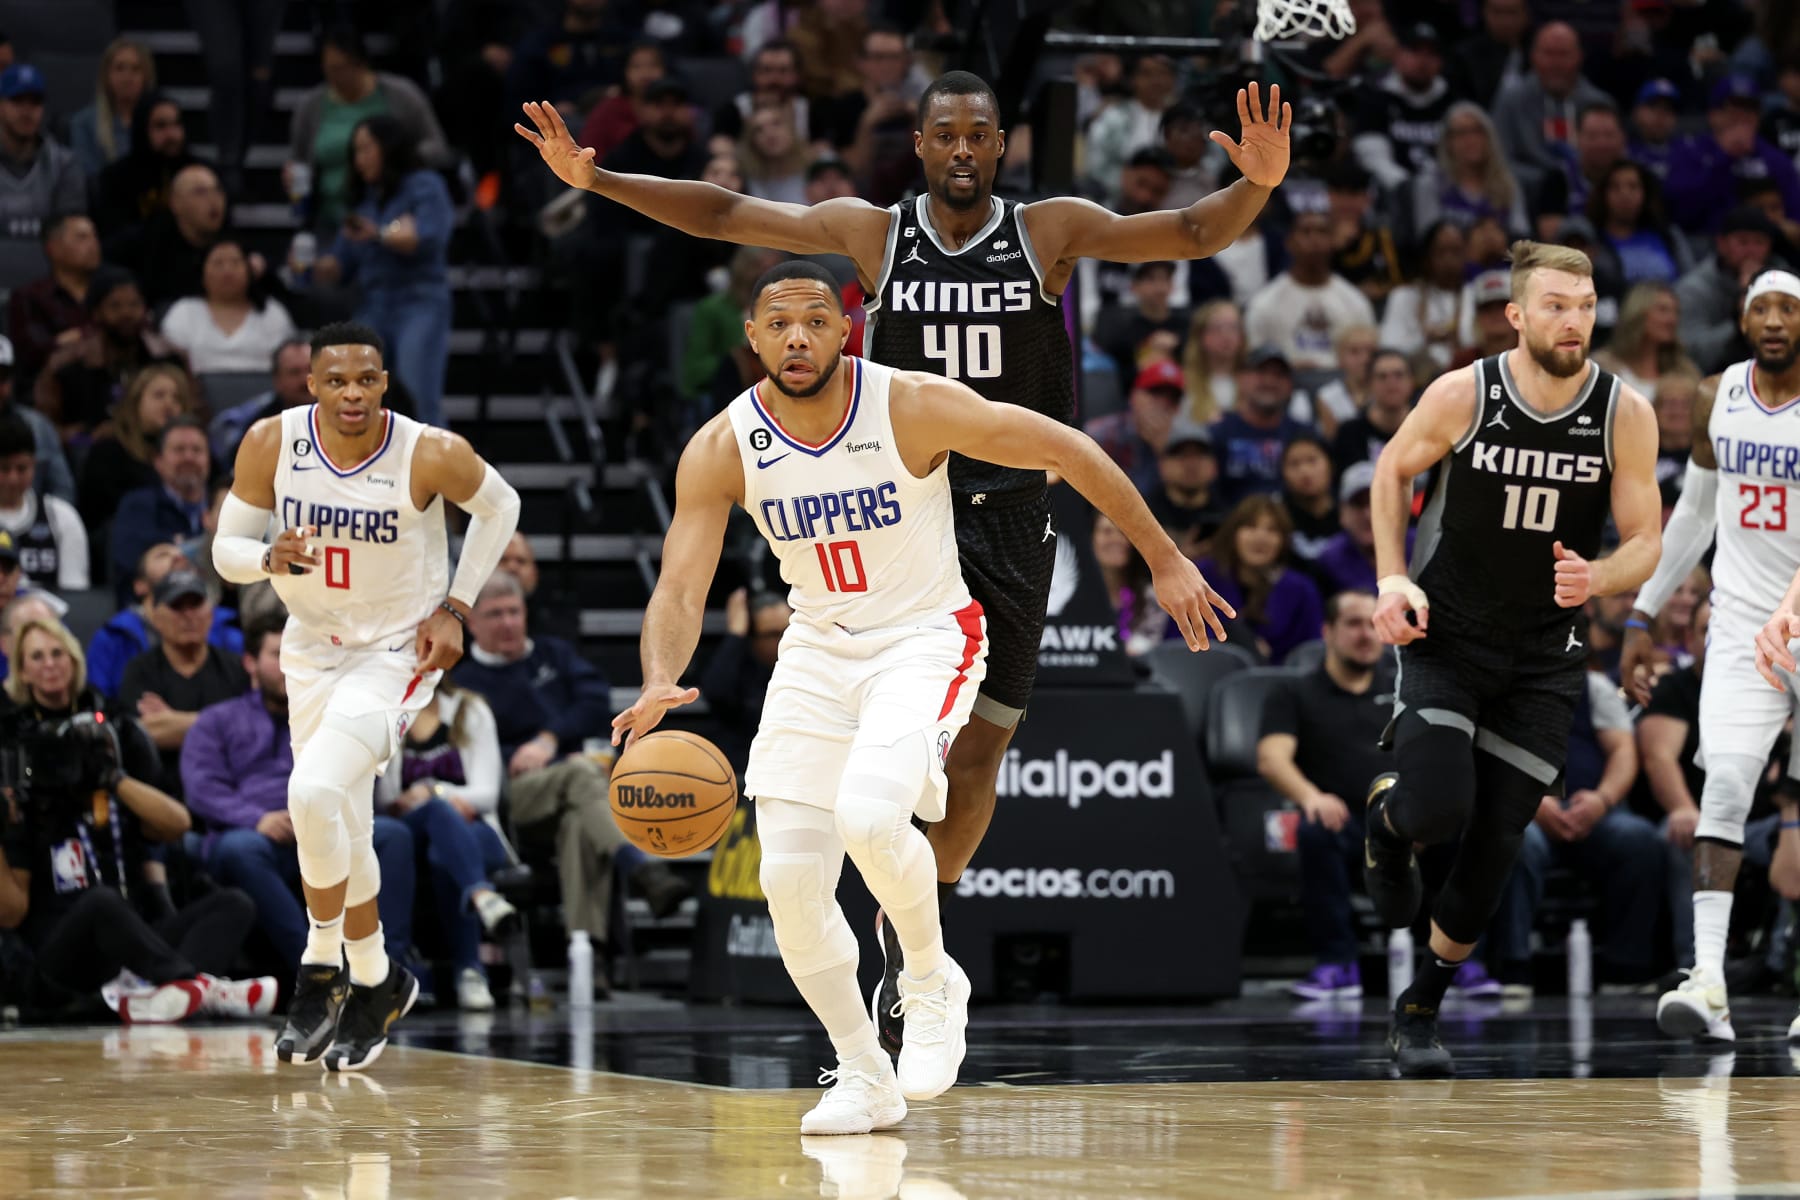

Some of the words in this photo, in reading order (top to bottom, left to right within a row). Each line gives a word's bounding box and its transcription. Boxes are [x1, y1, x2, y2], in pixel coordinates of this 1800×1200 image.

[904, 226, 916, 237] 6
[986, 250, 1021, 263] dialpad
[892, 281, 1031, 313] KINGS
[923, 325, 1002, 378] 40
[1490, 384, 1501, 399] 6
[753, 430, 769, 449] 6
[845, 440, 881, 453] honey
[1568, 427, 1600, 437] dialpad
[1471, 441, 1603, 483] KINGS
[1717, 437, 1800, 481] CLIPPER
[367, 475, 395, 487] honey
[283, 496, 399, 544] CLIPPERS
[760, 480, 902, 541] CLIPPERS
[1502, 484, 1560, 532] 10
[1739, 483, 1787, 531] 23
[325, 546, 350, 590] 0
[815, 540, 867, 592] 10
[1040, 625, 1116, 650] AWK
[617, 785, 697, 808] Wilson
[957, 868, 1175, 898] socios.com
